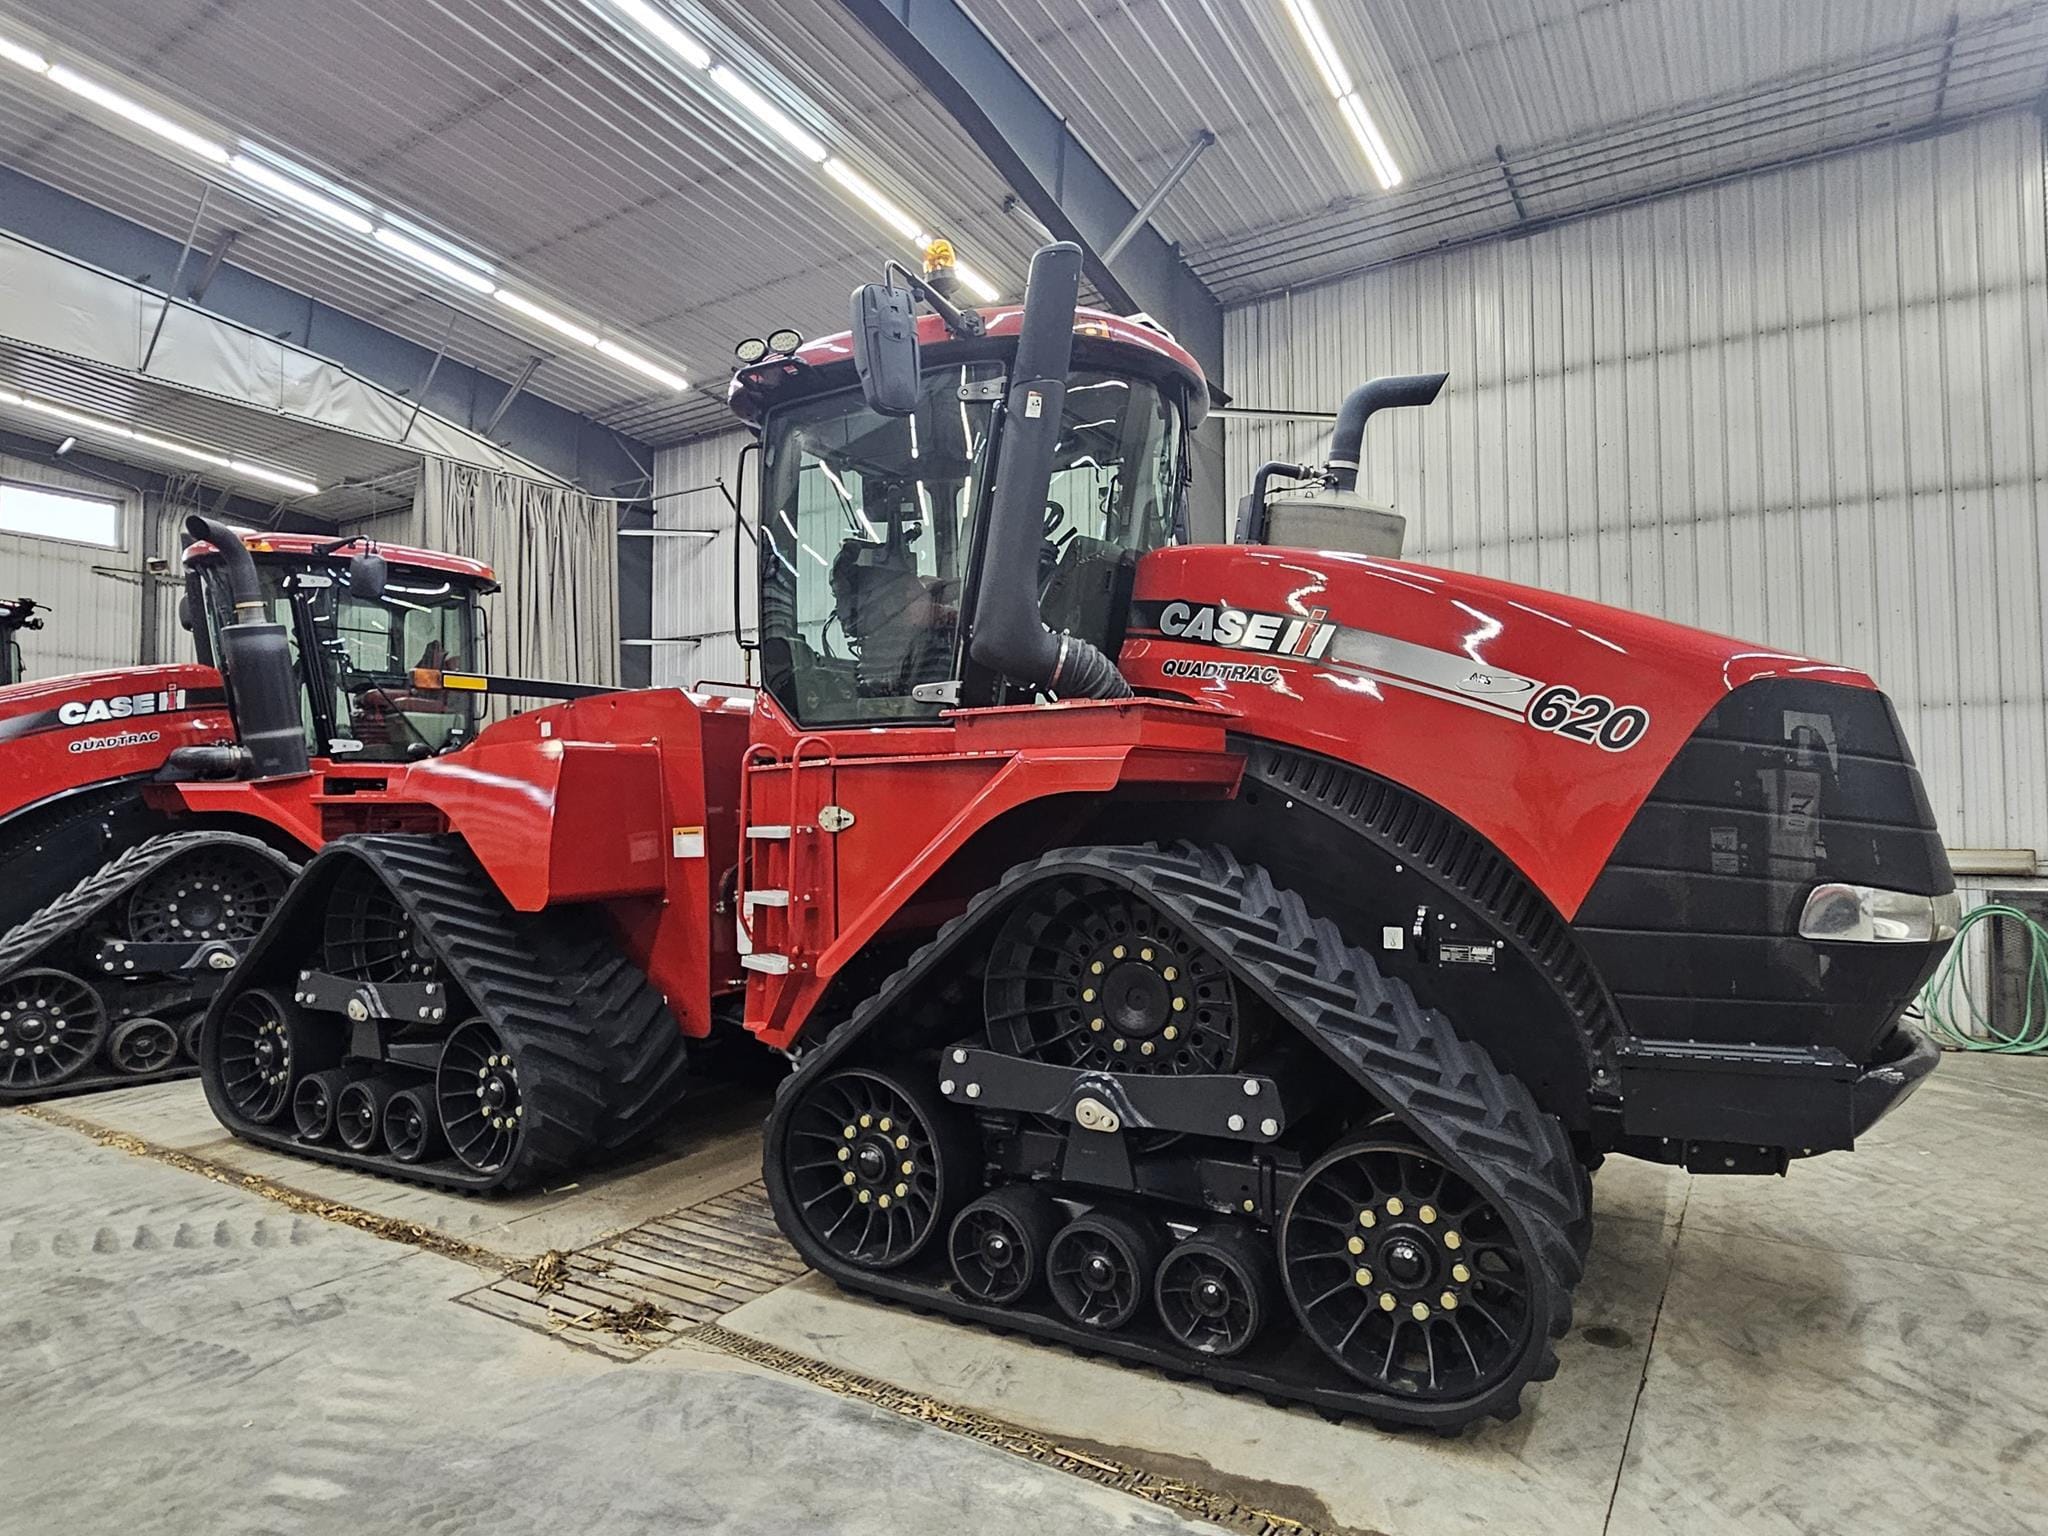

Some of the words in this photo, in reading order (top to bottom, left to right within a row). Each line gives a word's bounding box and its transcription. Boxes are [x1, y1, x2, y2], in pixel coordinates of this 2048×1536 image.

[1159, 601, 1284, 651] CASE
[1161, 658, 1280, 685] QUADTRAC
[58, 693, 156, 726] CASE
[1528, 684, 1651, 753] 620
[68, 730, 160, 754] QUADTRAC
